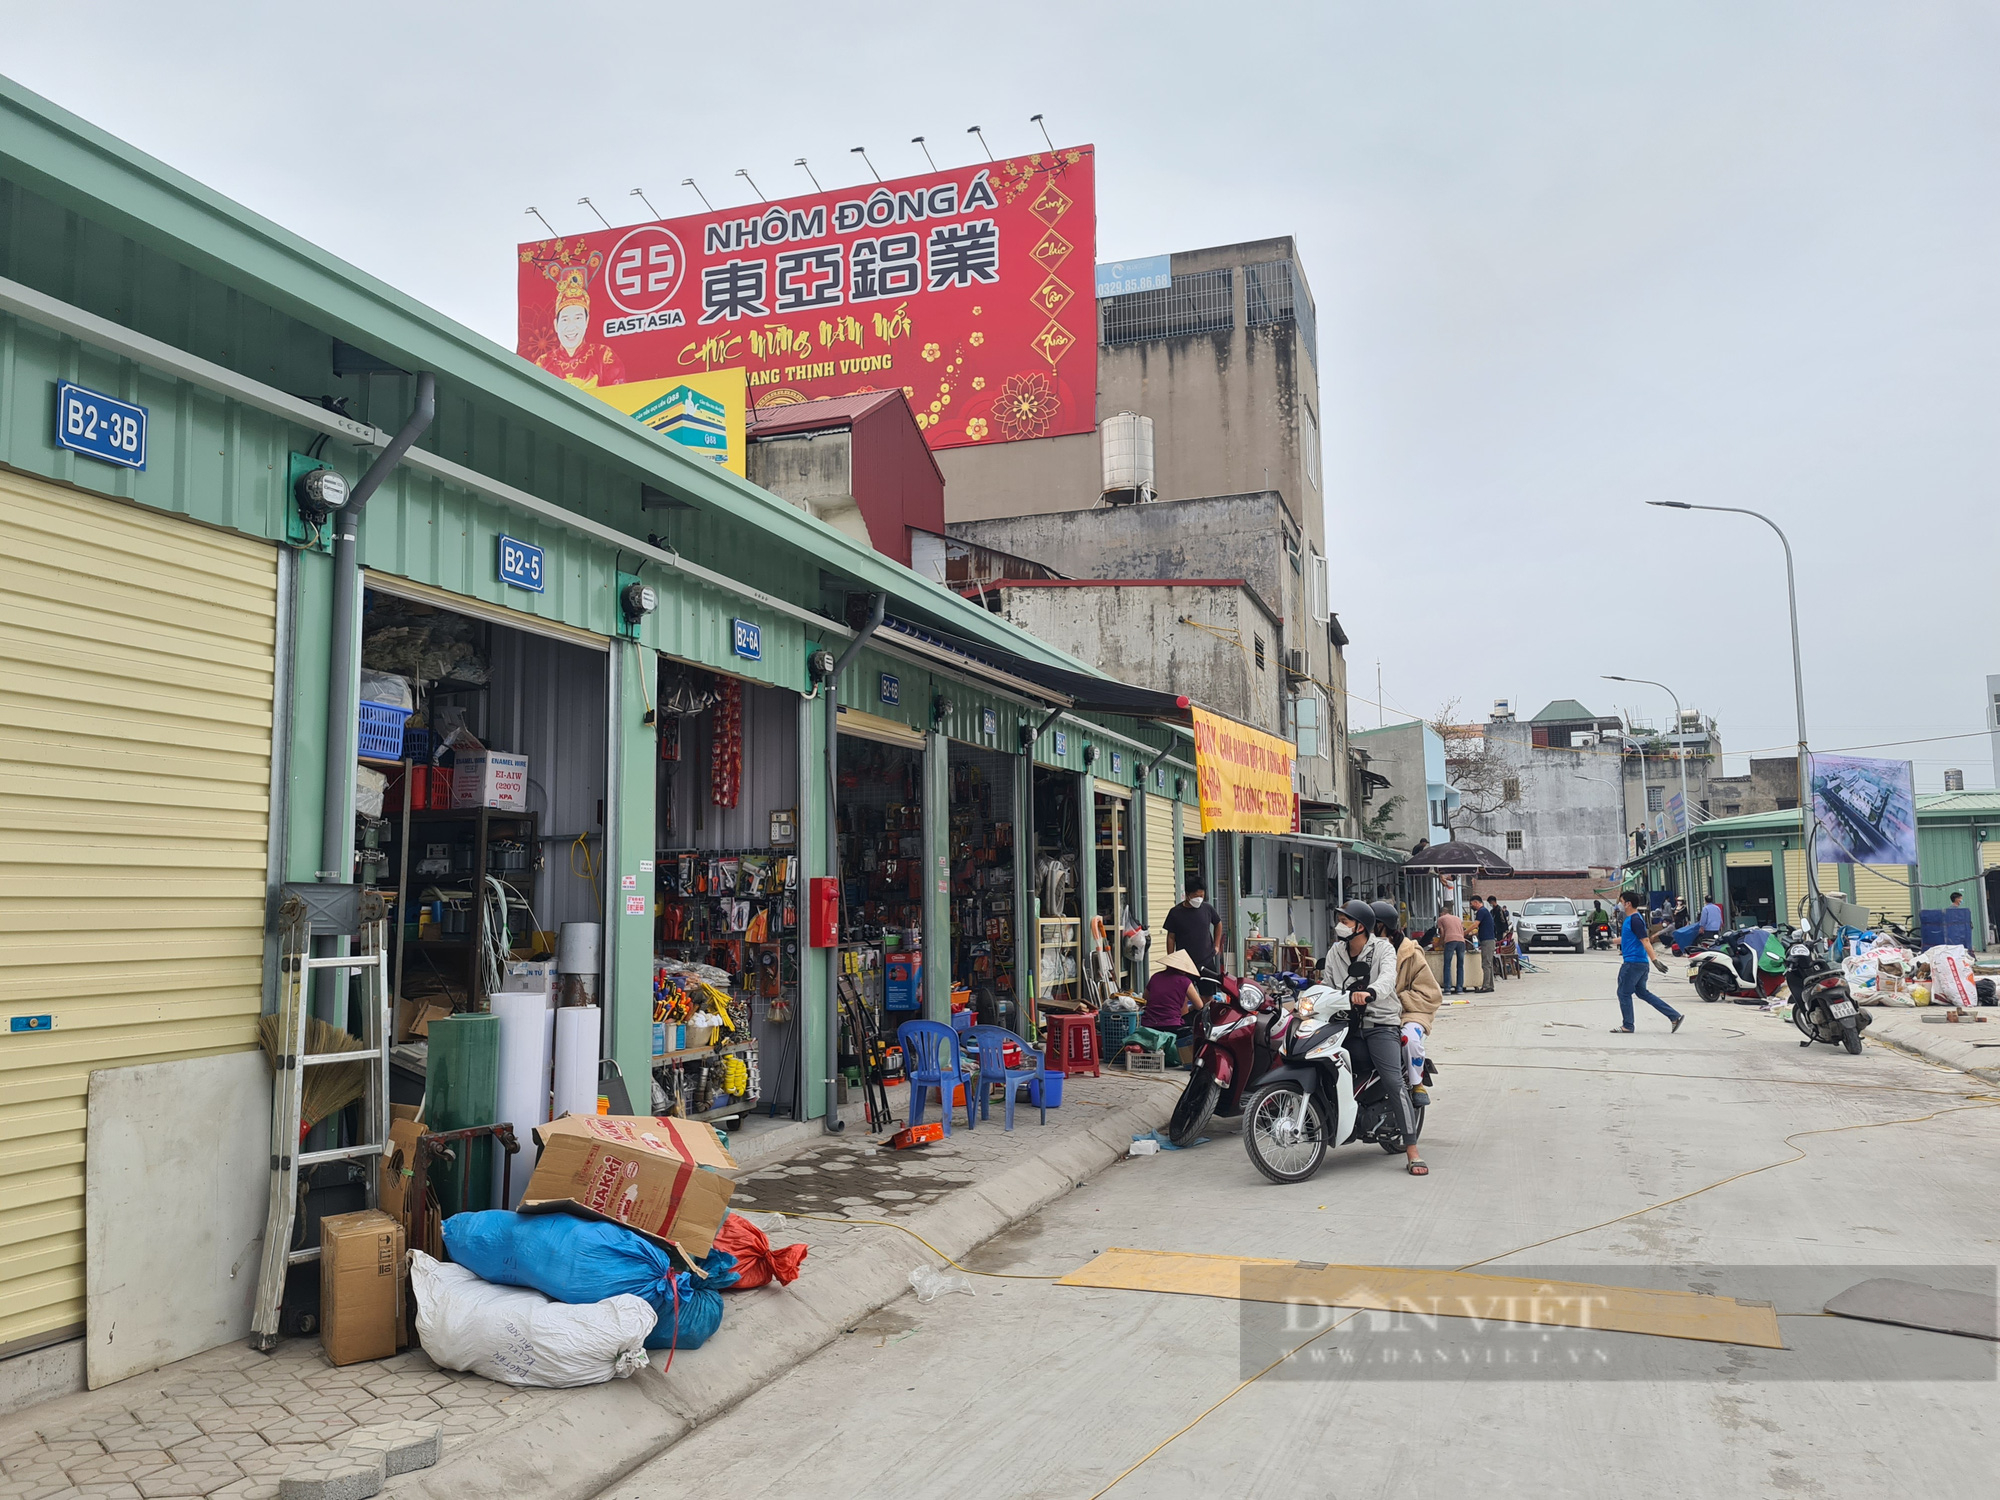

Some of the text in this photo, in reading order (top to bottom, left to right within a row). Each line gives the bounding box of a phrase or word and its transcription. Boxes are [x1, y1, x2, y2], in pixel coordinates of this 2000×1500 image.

[706, 170, 995, 253] NHÔM ĐÔNG Á
[698, 220, 998, 324] 東亞鋁業
[1098, 273, 1168, 297] 0329.85.86.68
[605, 311, 683, 335] EAST ASIA
[785, 360, 835, 383] THỊNH
[839, 353, 893, 375] VƯỢNG
[67, 398, 138, 452] B2-3B
[505, 546, 540, 580] B2-5
[736, 626, 760, 652] B2-6A
[881, 680, 899, 700] B2-6B
[491, 757, 527, 768] ENAMEL WIRE
[495, 770, 522, 780] EI-AIW
